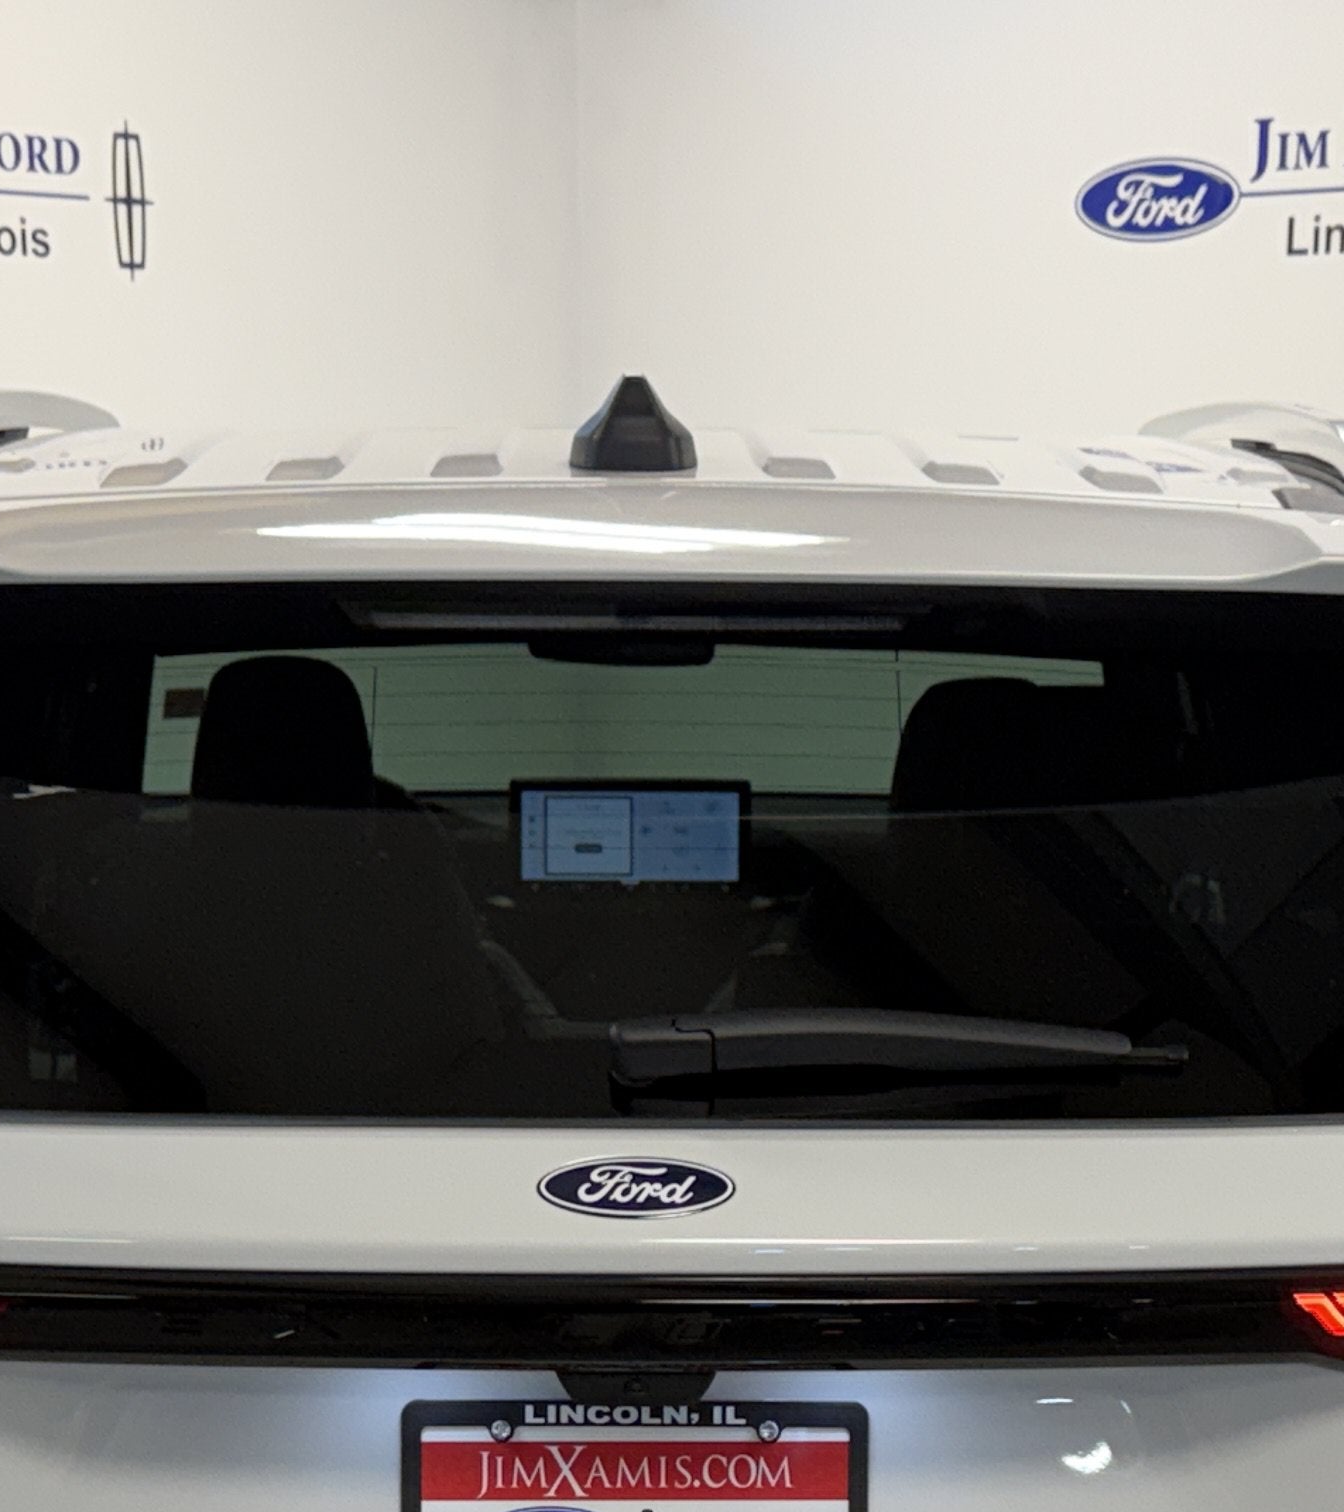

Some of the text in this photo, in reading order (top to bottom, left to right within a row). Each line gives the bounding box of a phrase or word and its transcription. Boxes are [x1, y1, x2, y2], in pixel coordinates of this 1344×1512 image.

[1251, 118, 1330, 183] JIM
[1106, 173, 1204, 228] Ford
[577, 1165, 696, 1203] Ford
[524, 1404, 747, 1425] LINCOLN, IL
[477, 1445, 792, 1498] JIMXAMIS.COM
